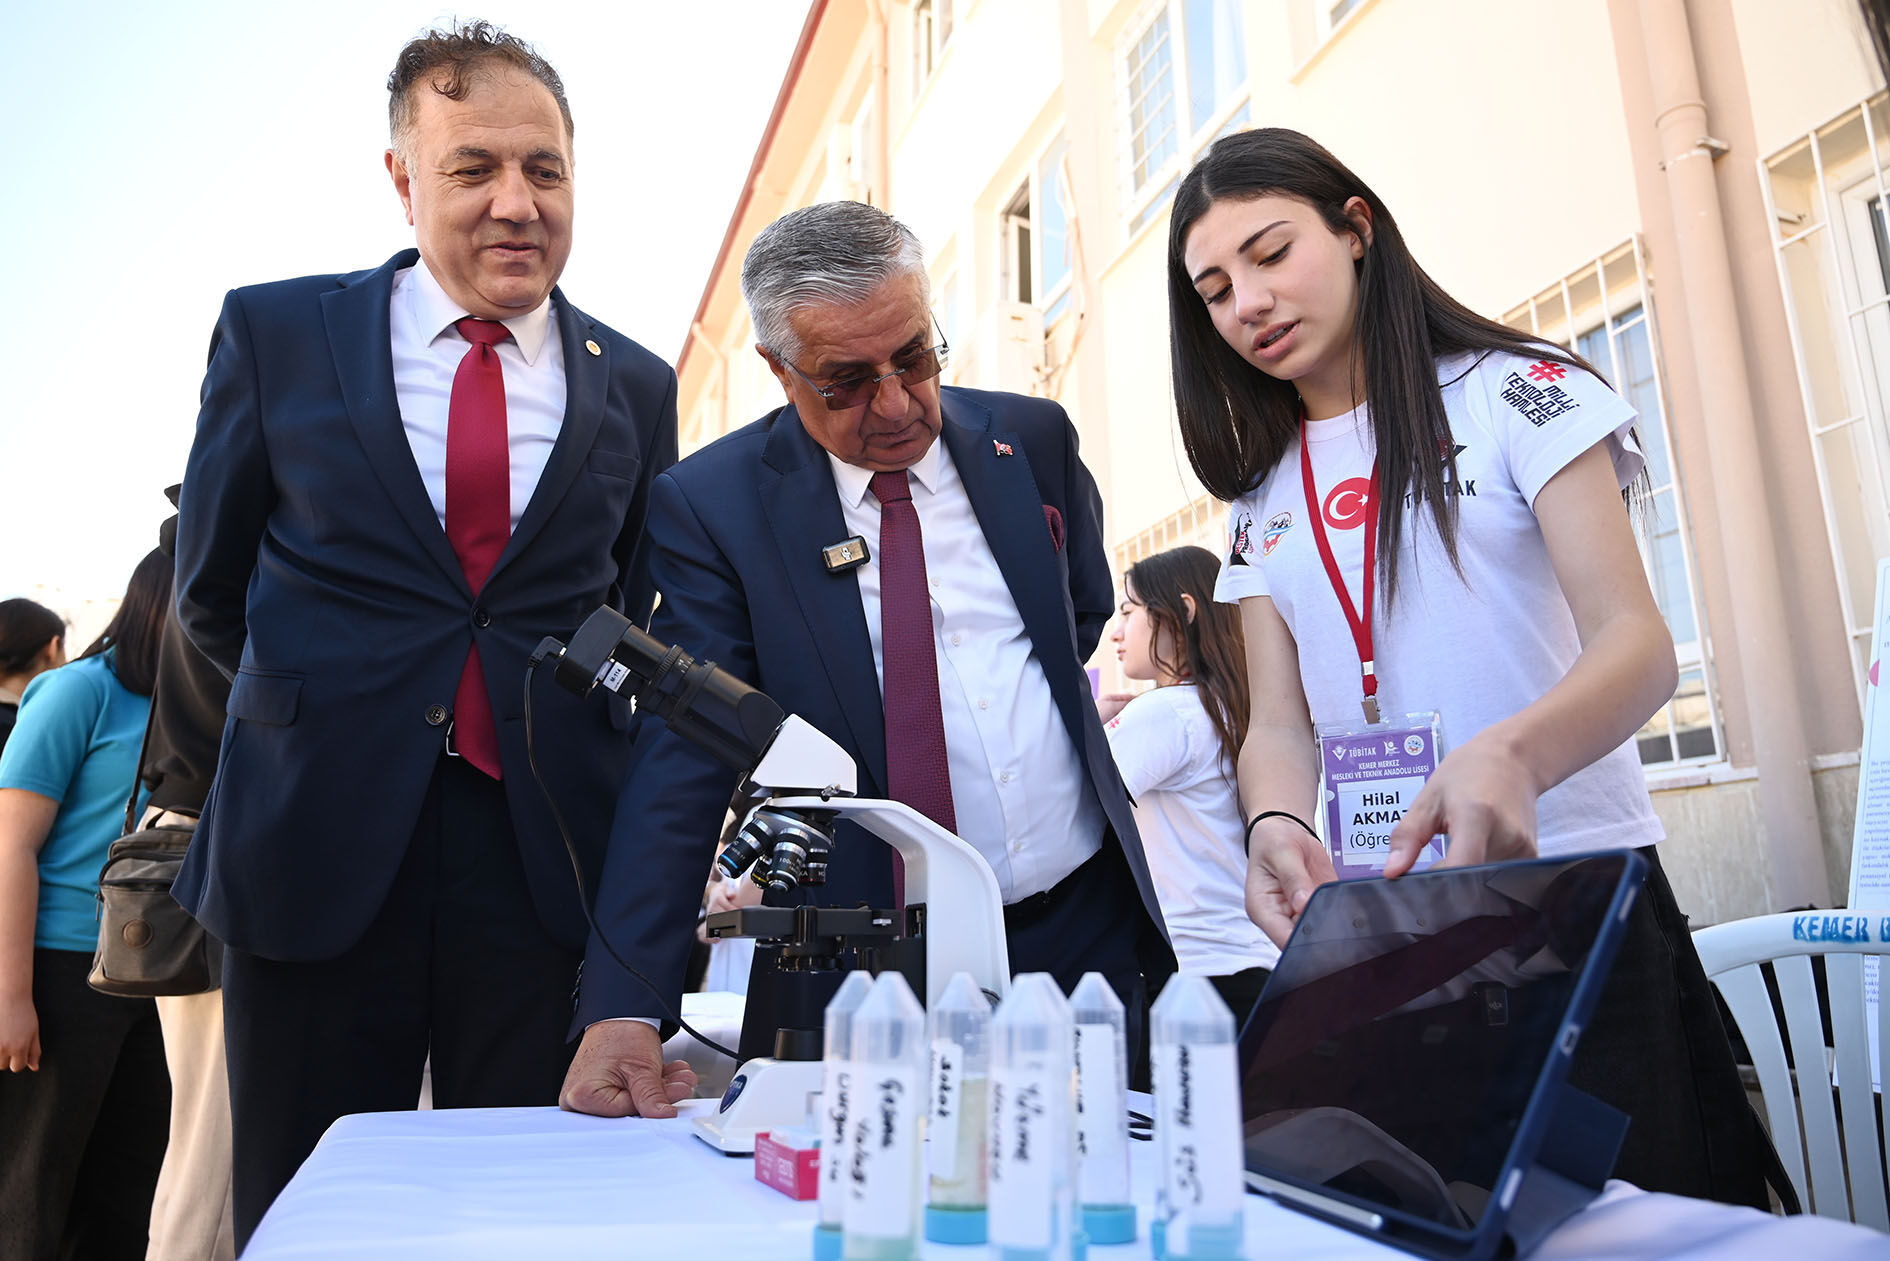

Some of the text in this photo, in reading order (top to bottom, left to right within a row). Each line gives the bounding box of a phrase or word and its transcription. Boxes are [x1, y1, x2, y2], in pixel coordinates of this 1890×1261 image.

[1505, 371, 1566, 418] TEKNOLOJİ
[1499, 387, 1551, 427] HAMLESİ
[1349, 746, 1376, 758] TÜBİTAK
[1355, 771, 1362, 779] VE
[1383, 767, 1412, 776] ANADOLU
[1412, 764, 1430, 774] LİSESİ
[1359, 759, 1400, 770] KEMER MERKEZ
[1362, 791, 1400, 807] Hilal
[1353, 809, 1408, 826] AKMA
[1350, 831, 1391, 849] (Öğre
[1793, 916, 1870, 943] KEMER
